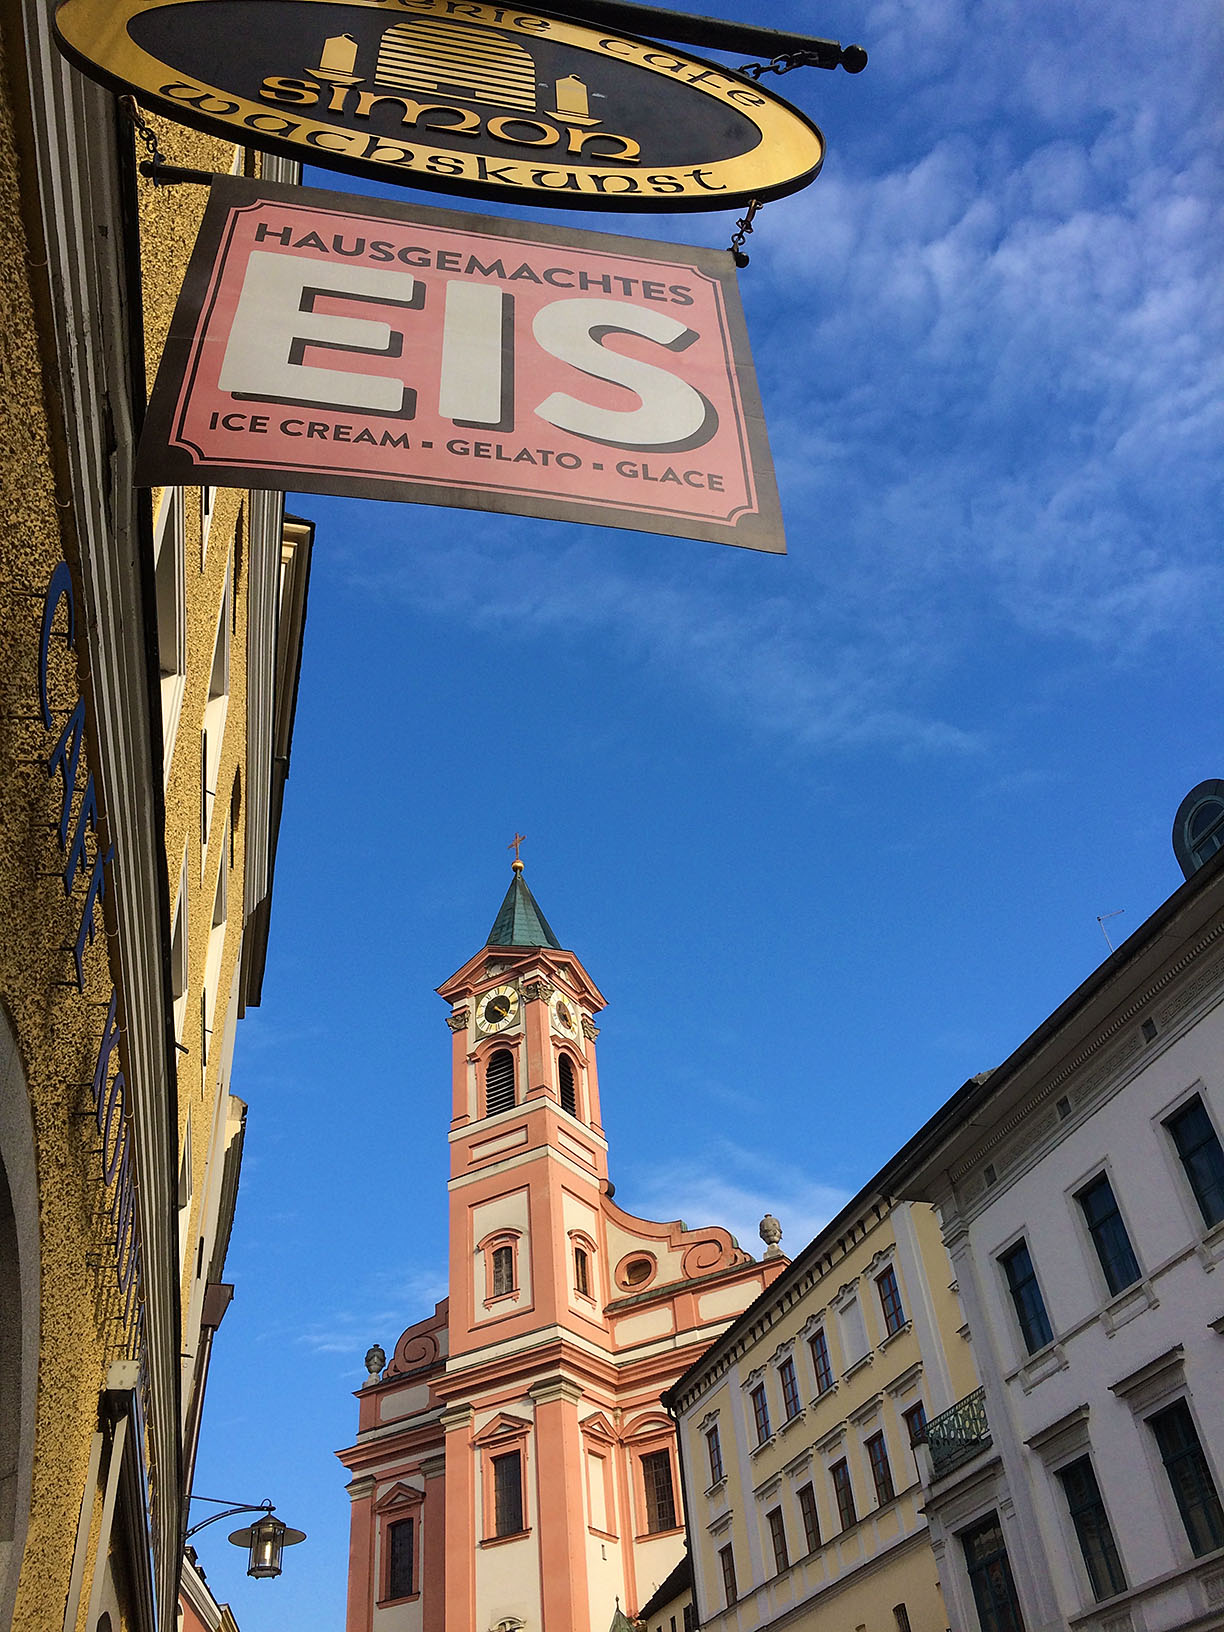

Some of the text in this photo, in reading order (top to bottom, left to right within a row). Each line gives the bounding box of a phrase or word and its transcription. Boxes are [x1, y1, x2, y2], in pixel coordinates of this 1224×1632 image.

[366, 0, 551, 32] erie
[158, 80, 728, 194] wachskunst
[258, 75, 642, 163] simon
[254, 222, 695, 306] HAUSGEMACHTES
[217, 250, 720, 454] EIS
[208, 411, 726, 493] ICE CREAM GELATO GLACE
